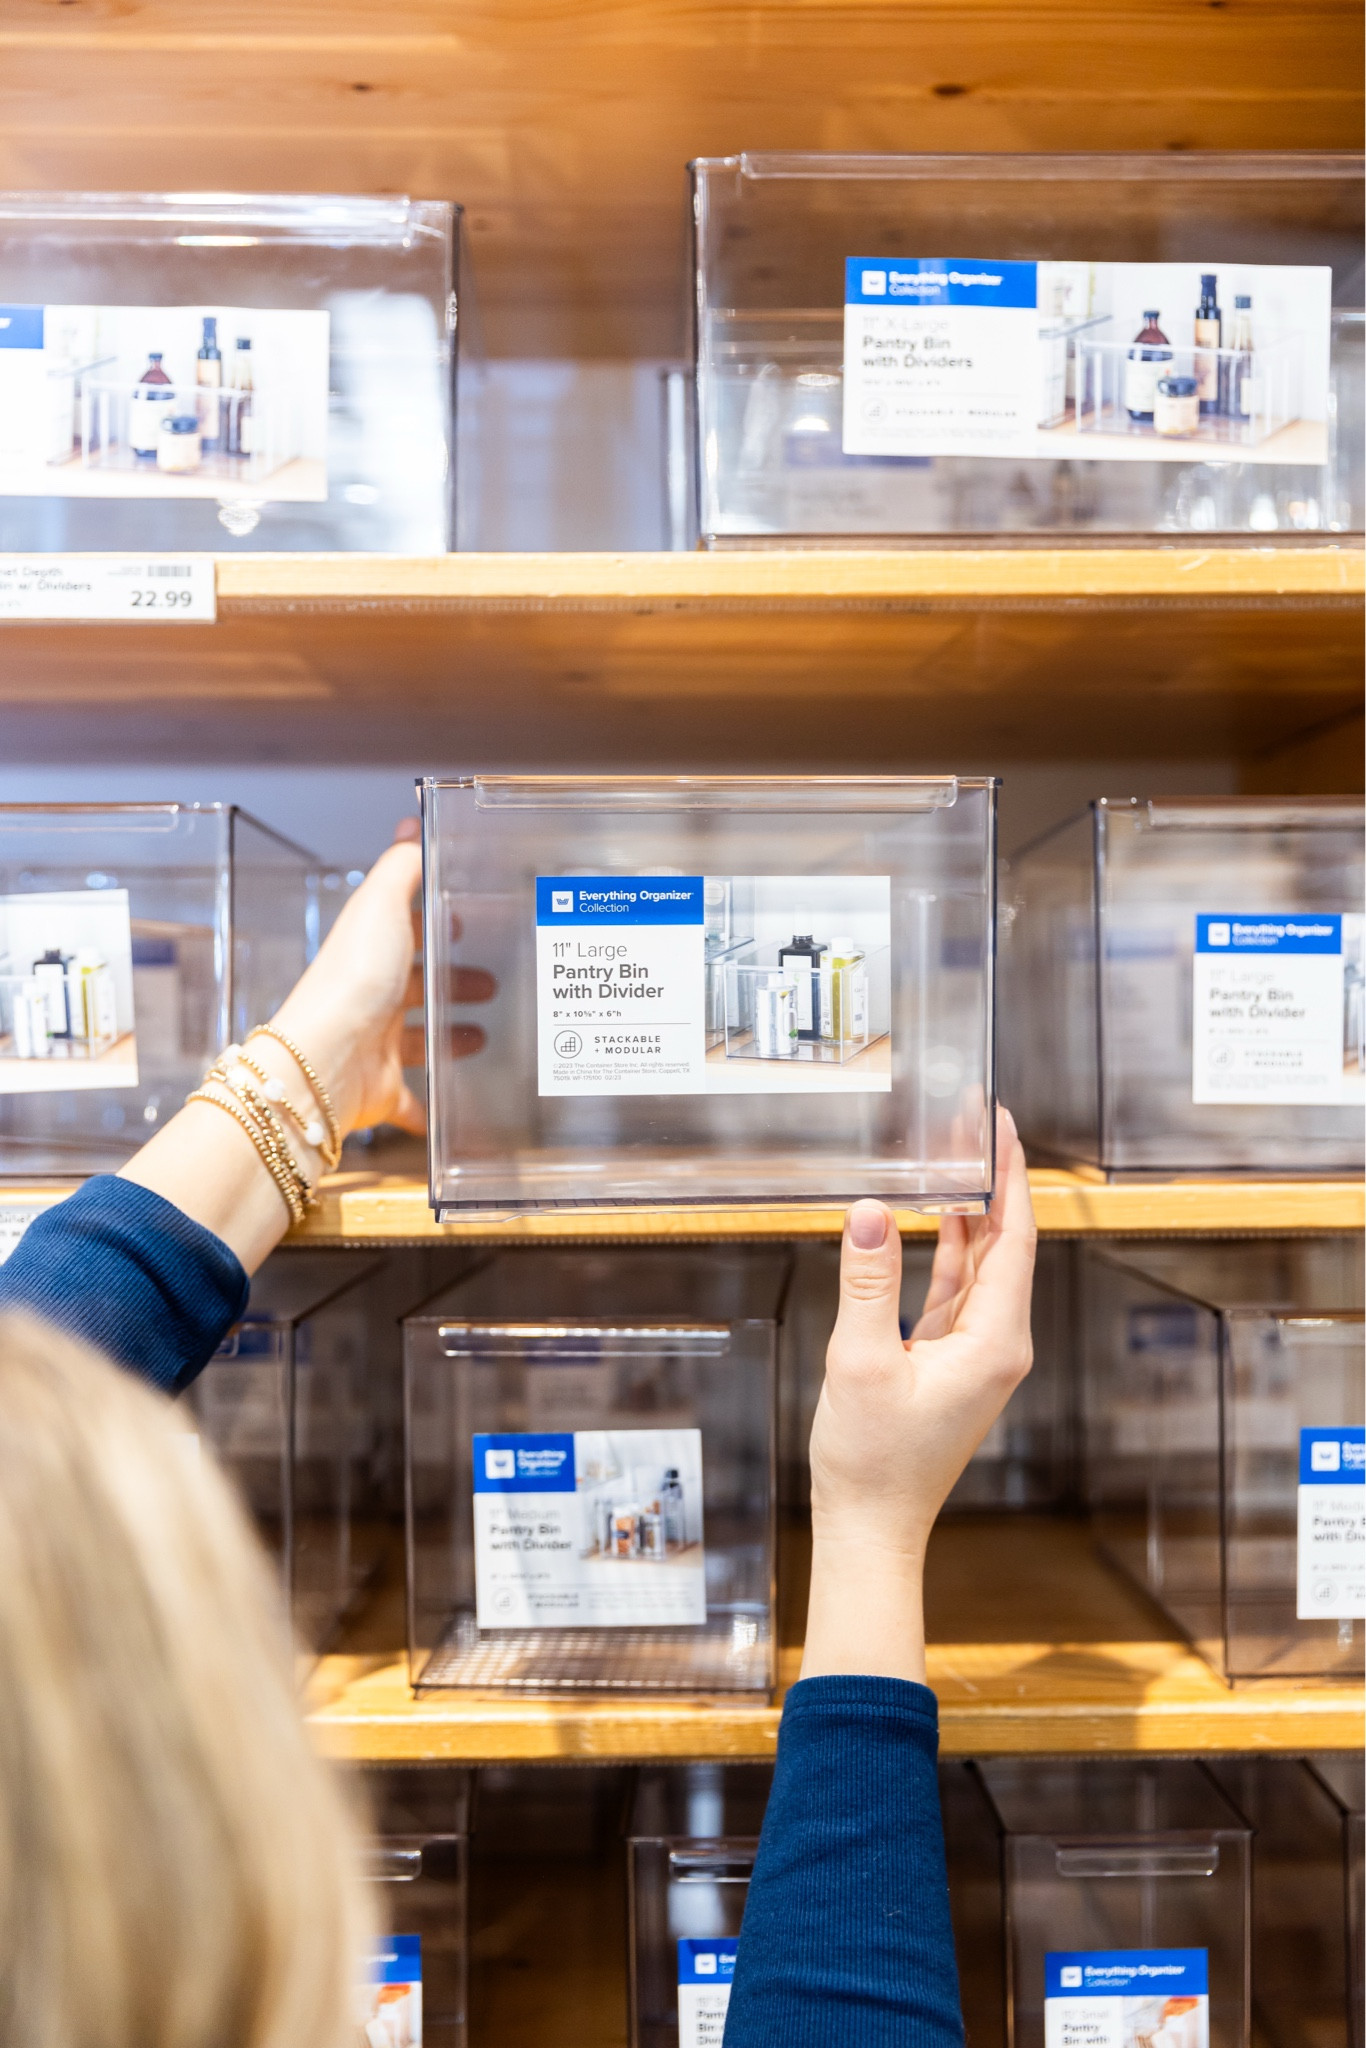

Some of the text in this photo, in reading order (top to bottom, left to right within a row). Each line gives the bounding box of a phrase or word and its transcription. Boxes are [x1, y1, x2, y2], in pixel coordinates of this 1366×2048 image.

[889, 271, 1002, 286] Everything Organizer
[863, 335, 950, 351] Pantry Bin
[863, 354, 973, 368] with Dividers
[131, 591, 192, 607] 22.99
[579, 890, 692, 902] Everything Organizer
[579, 903, 629, 913] Collection
[1232, 923, 1333, 938] Everything Organizer
[552, 942, 627, 961] 11" Large
[553, 963, 649, 982] Pantry Bin
[553, 983, 664, 999] with Divider
[1209, 988, 1294, 1003] Pantry Bin
[1209, 1005, 1305, 1018] with Divider
[594, 1035, 661, 1044] STACKABLE
[605, 1046, 662, 1054] MODULAR
[648, 1061, 664, 1069] rights
[517, 1450, 566, 1461] Everything
[490, 1522, 561, 1537] Pantry Bin
[1313, 1516, 1355, 1529] Pantry
[1084, 1964, 1186, 1979] Everything Organizer
